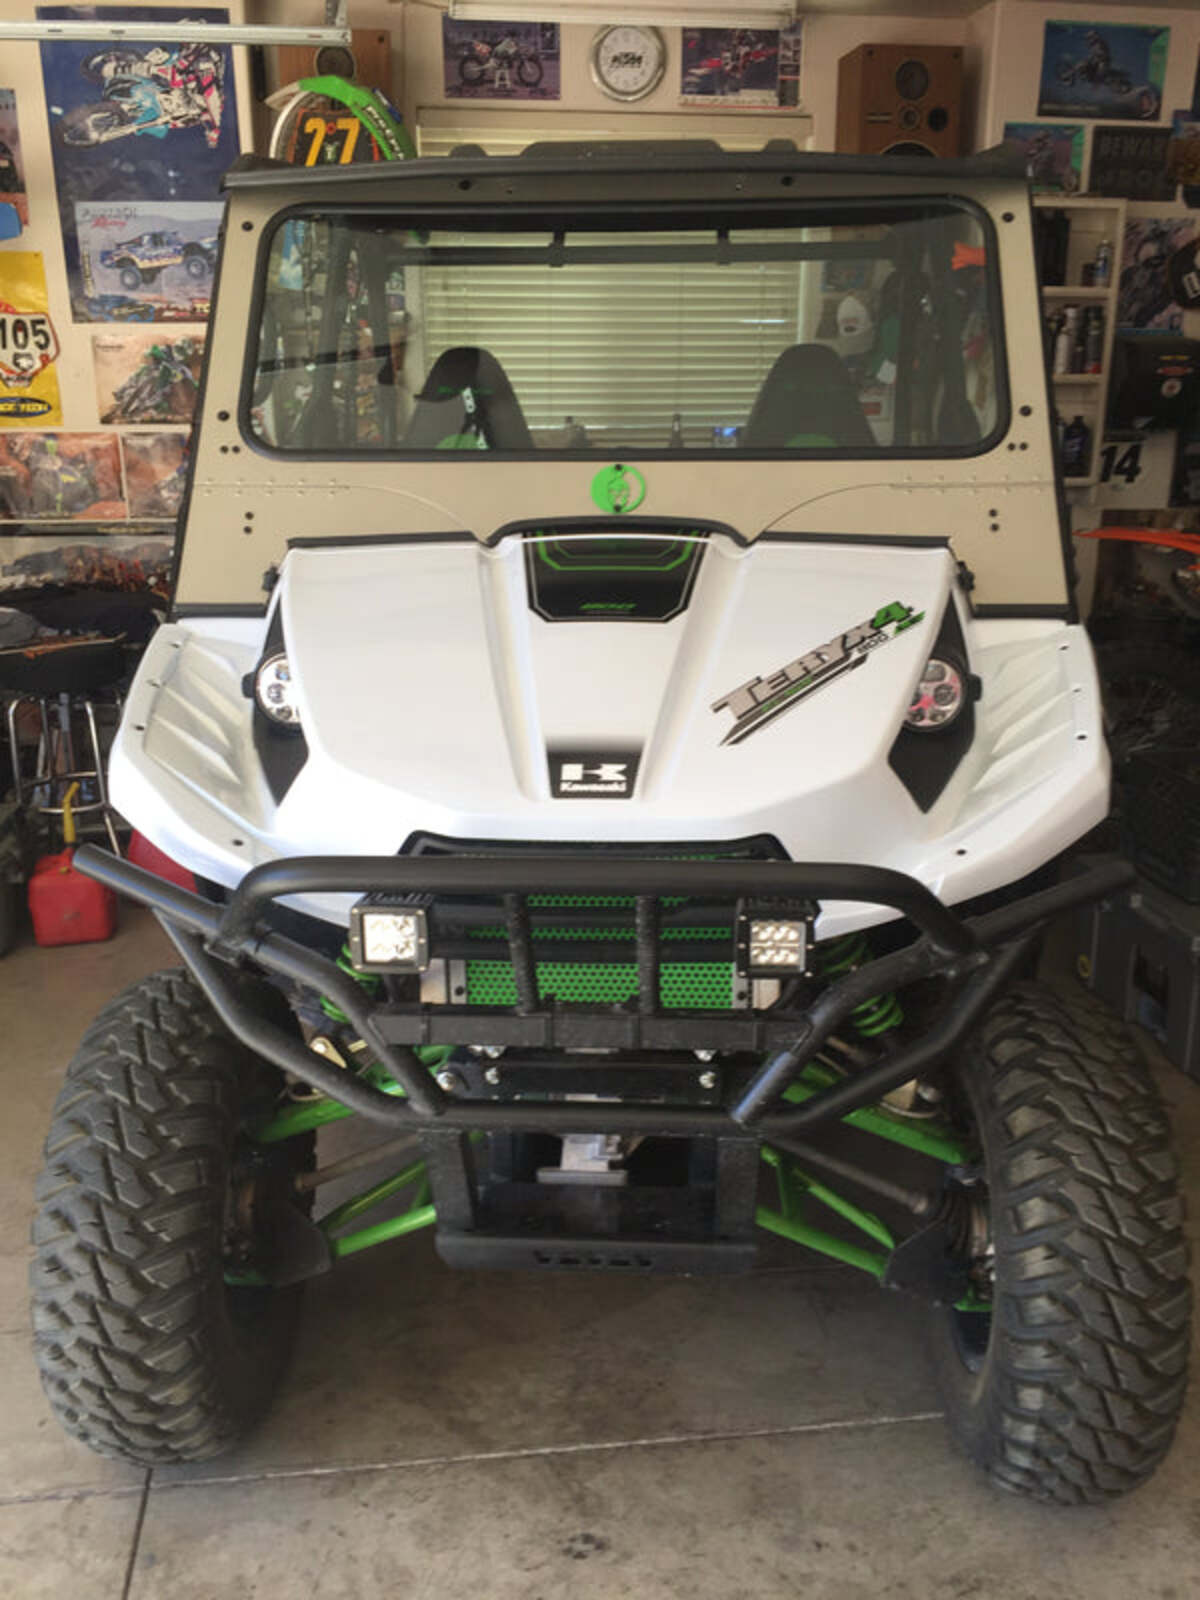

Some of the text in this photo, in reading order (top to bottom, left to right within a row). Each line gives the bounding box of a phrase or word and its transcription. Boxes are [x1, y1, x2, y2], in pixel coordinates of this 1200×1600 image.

[611, 51, 643, 65] KTM
[1099, 135, 1167, 159] BEWAR
[1100, 444, 1142, 483] 14
[560, 781, 627, 793] Kawasaki
